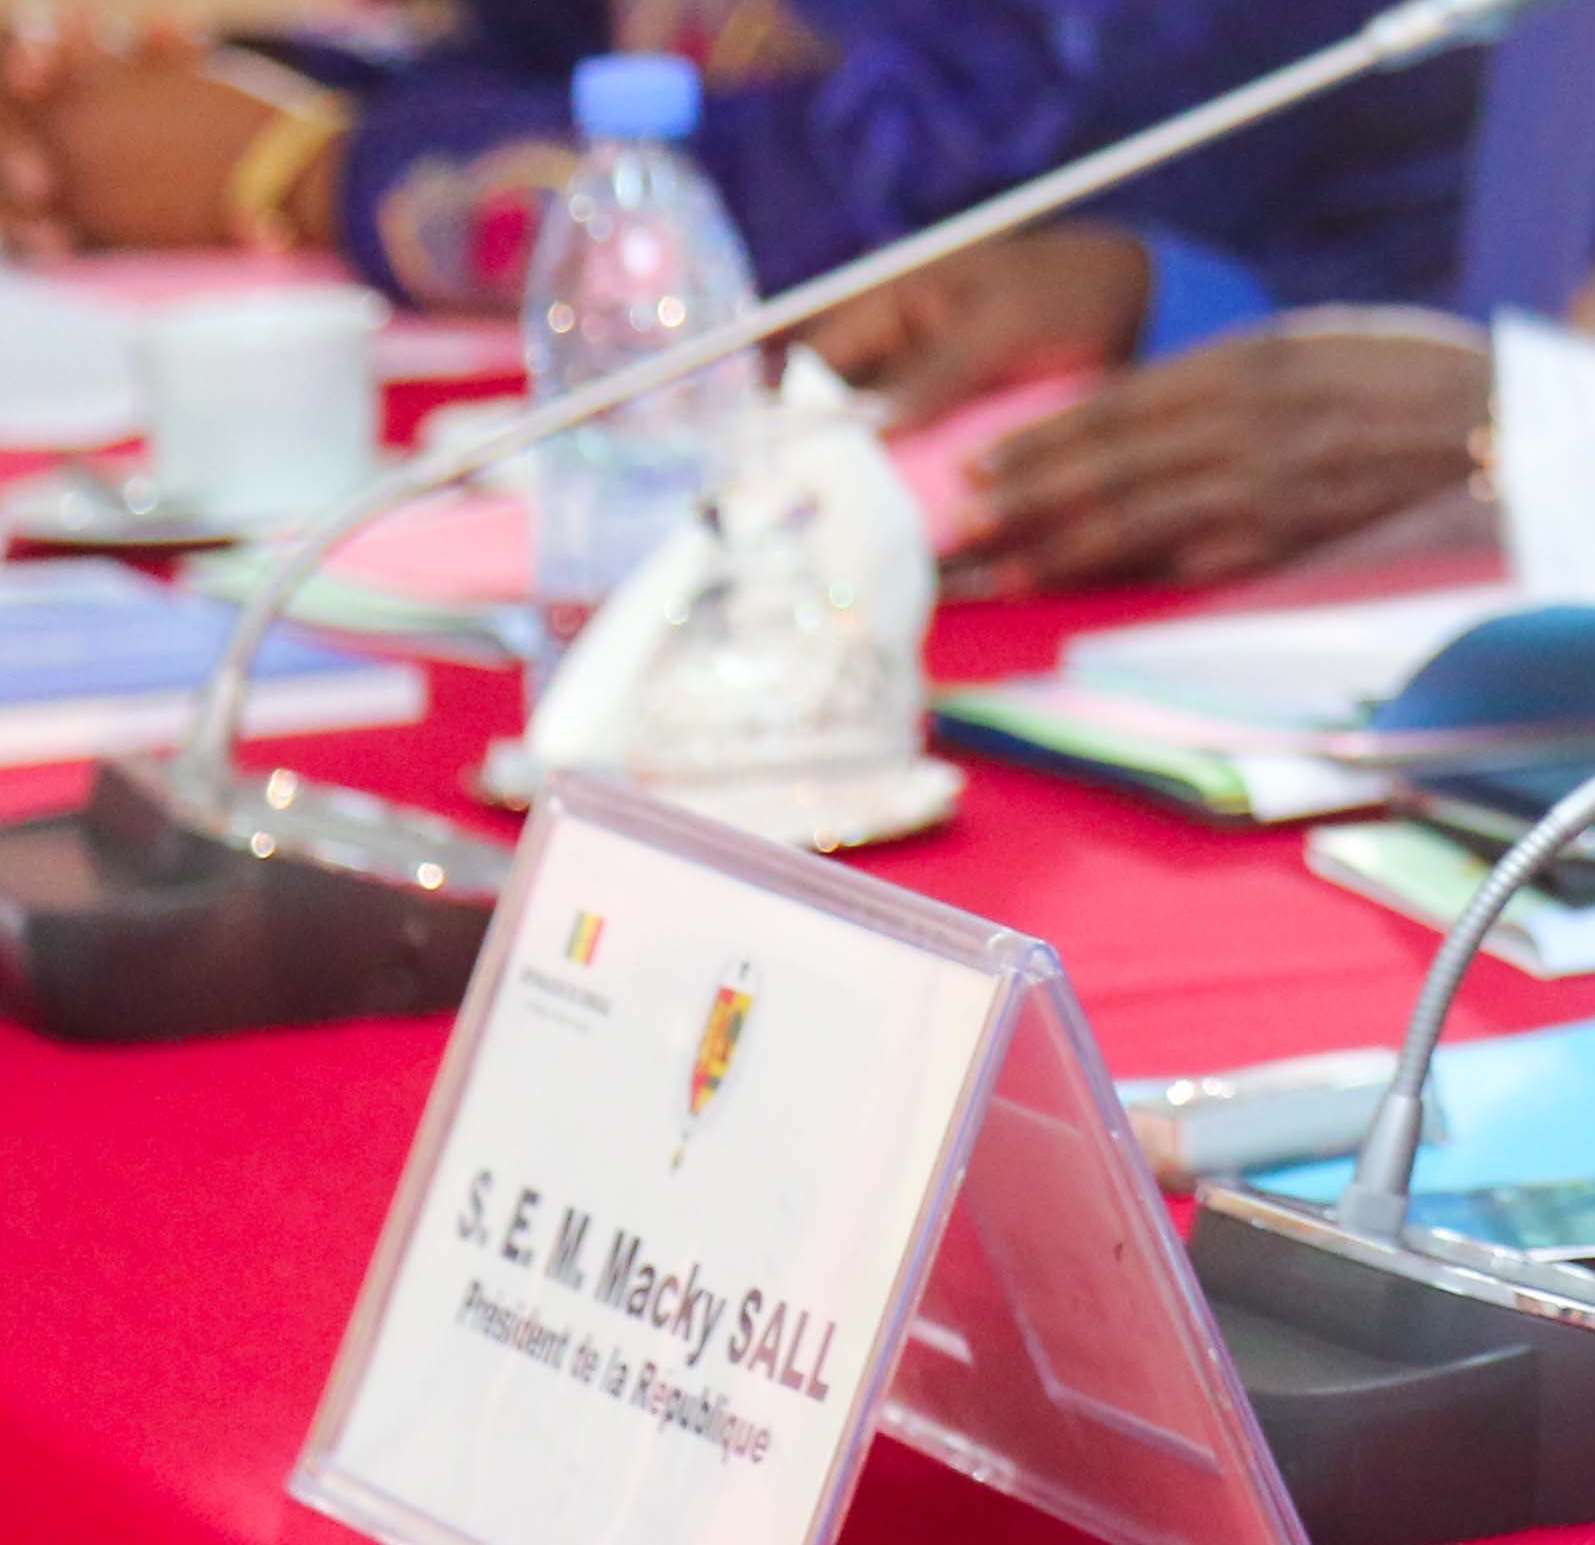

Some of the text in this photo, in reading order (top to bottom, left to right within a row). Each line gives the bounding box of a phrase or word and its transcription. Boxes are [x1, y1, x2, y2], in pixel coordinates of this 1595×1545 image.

[456, 1168, 837, 1403] S. E. M. Macky SALL
[569, 1333, 600, 1384] de
[600, 1346, 628, 1399] la
